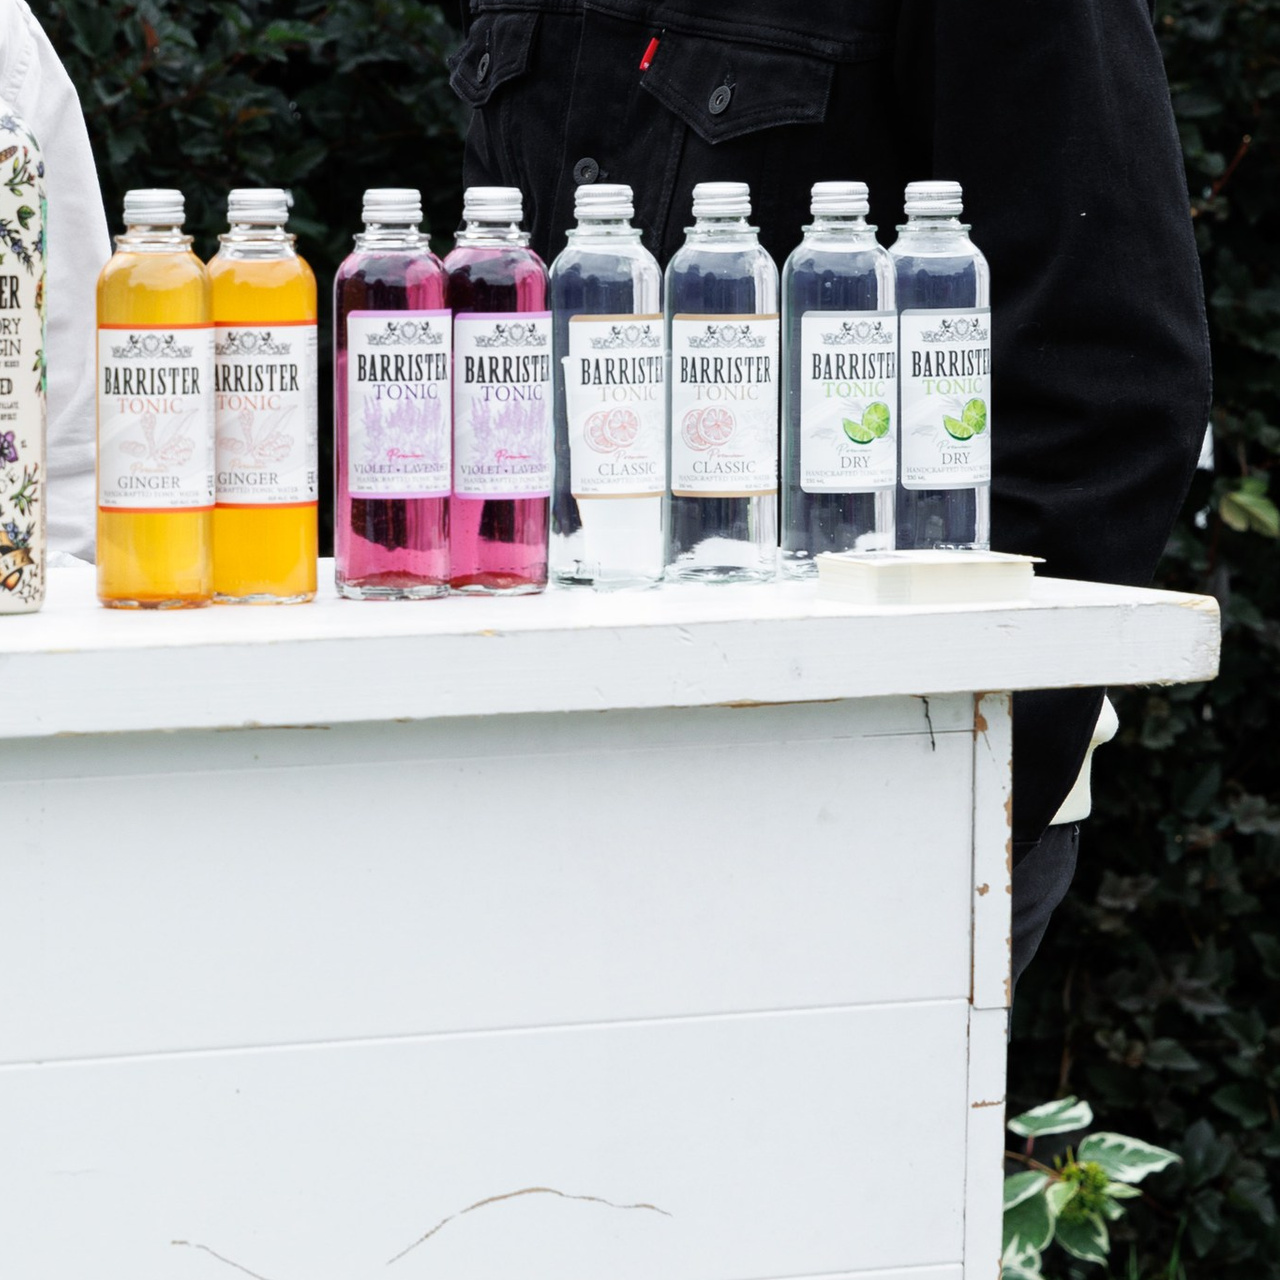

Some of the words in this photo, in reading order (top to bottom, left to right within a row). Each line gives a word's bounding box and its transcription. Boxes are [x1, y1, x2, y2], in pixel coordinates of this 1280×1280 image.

[357, 352, 448, 382] BARRISTER
[680, 356, 772, 384] BARRISTER
[103, 367, 201, 396] BARRISTER
[215, 363, 300, 392] ARRISTER
[922, 377, 983, 395] TONIC
[372, 383, 439, 400] TONIC
[481, 384, 543, 401] TONIC
[598, 385, 658, 402] TONIC
[693, 385, 759, 401] TONIC
[822, 381, 886, 398] TONIC
[117, 397, 184, 415] TONIC
[218, 394, 282, 412] TONIC
[840, 456, 871, 469] DRY
[942, 452, 971, 465] DRY
[353, 464, 393, 474] VIOLET
[460, 465, 500, 475] VIOLET
[598, 462, 657, 476] CLASSIC
[692, 461, 756, 474] CLASSIC
[117, 475, 181, 490] GINGER
[218, 472, 279, 486] GINGER
